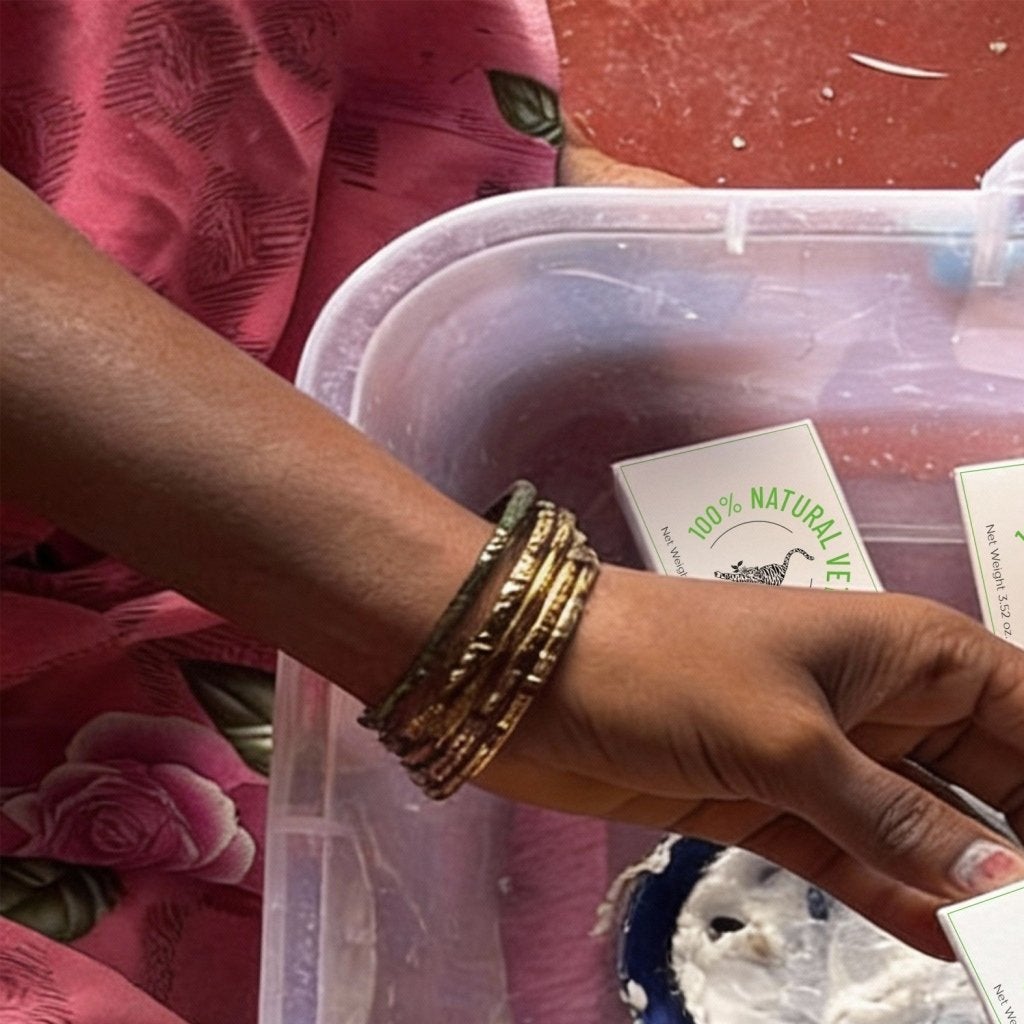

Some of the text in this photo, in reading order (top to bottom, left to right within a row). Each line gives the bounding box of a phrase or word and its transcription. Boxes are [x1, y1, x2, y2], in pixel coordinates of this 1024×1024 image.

[688, 493, 743, 540] 100%
[751, 486, 842, 550] NATURAL
[660, 526, 674, 546] Net
[985, 523, 998, 547] Net
[990, 547, 1006, 592] Weight
[997, 594, 1011, 619] 3.52
[993, 983, 1009, 1007] Net
